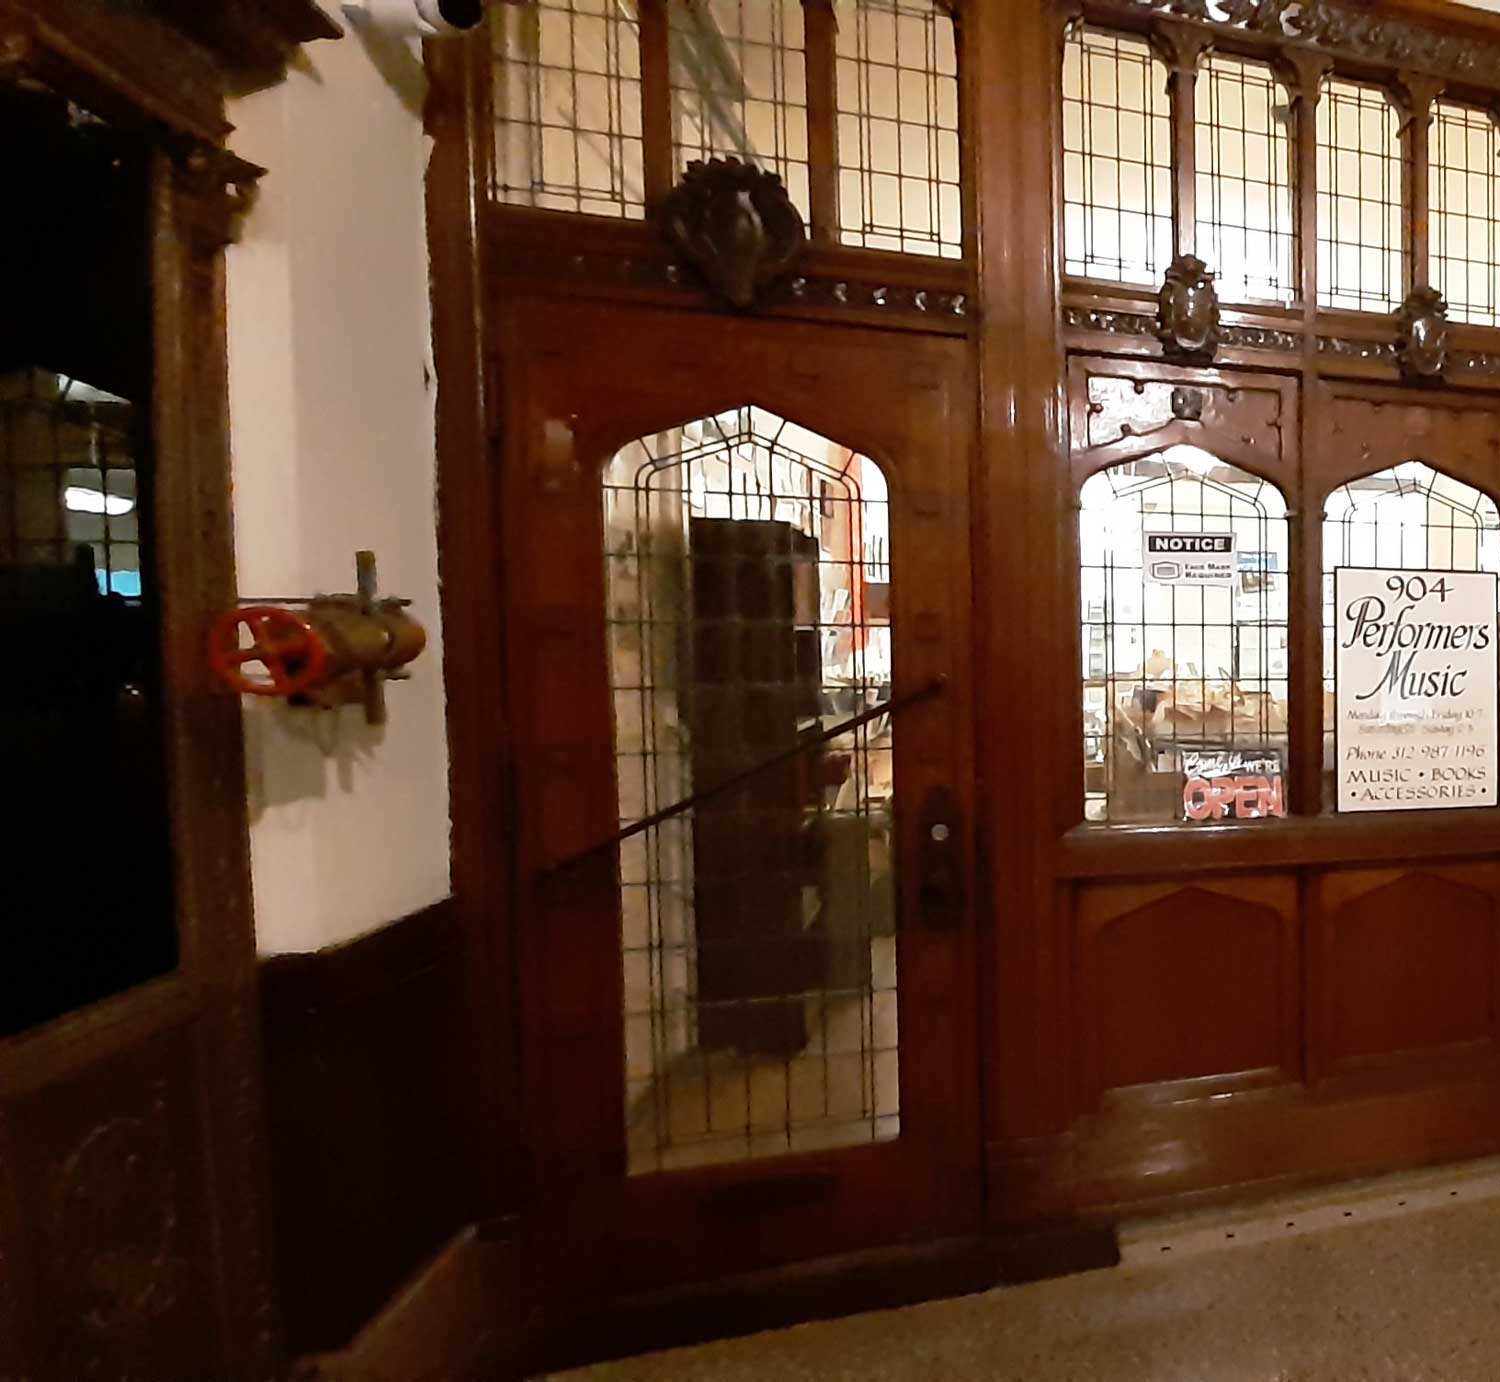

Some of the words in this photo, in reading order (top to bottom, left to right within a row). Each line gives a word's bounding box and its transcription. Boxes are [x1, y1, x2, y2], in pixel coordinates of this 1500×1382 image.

[1155, 537, 1225, 551] NOTICE
[1385, 575, 1455, 603] 904
[1342, 595, 1490, 658] Performers
[1355, 649, 1468, 701] Music
[1346, 744, 1387, 761] Phone
[1391, 745, 1416, 760] 312
[1421, 745, 1449, 760] 987
[1455, 744, 1486, 758] 1196
[1347, 768, 1412, 784] MUSIC
[1431, 767, 1487, 782] BOOKS
[1183, 775, 1284, 820] OPEN
[1360, 785, 1476, 801] ACCESSORIES
